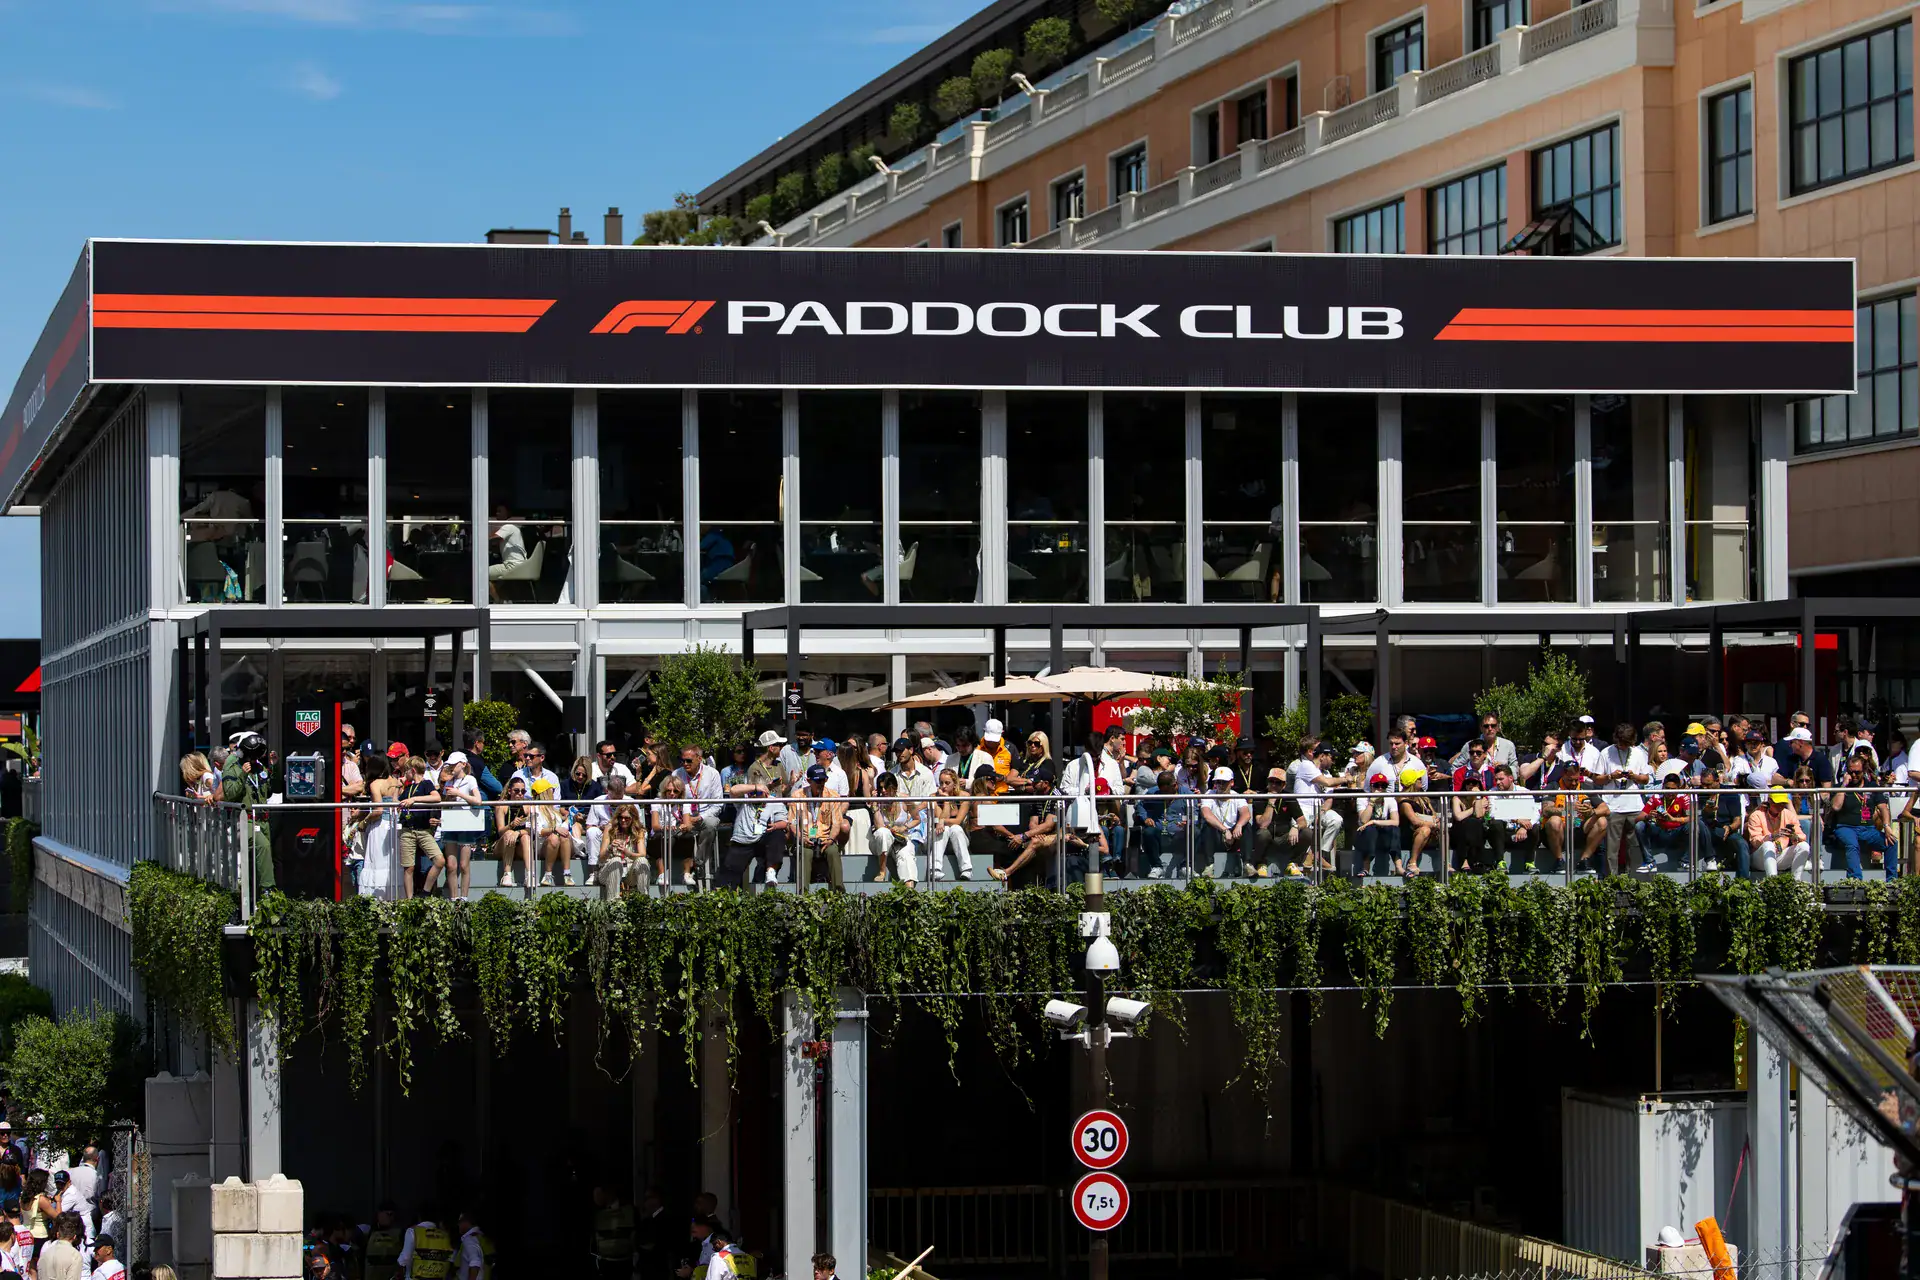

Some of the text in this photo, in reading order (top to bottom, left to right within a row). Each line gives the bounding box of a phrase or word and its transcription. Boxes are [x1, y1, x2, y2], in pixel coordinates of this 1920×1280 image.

[727, 300, 1161, 338] PADDOCK
[1179, 304, 1404, 340] CLUB
[298, 712, 319, 721] TAG
[297, 722, 320, 734] HEUER
[1084, 1127, 1118, 1153] 30
